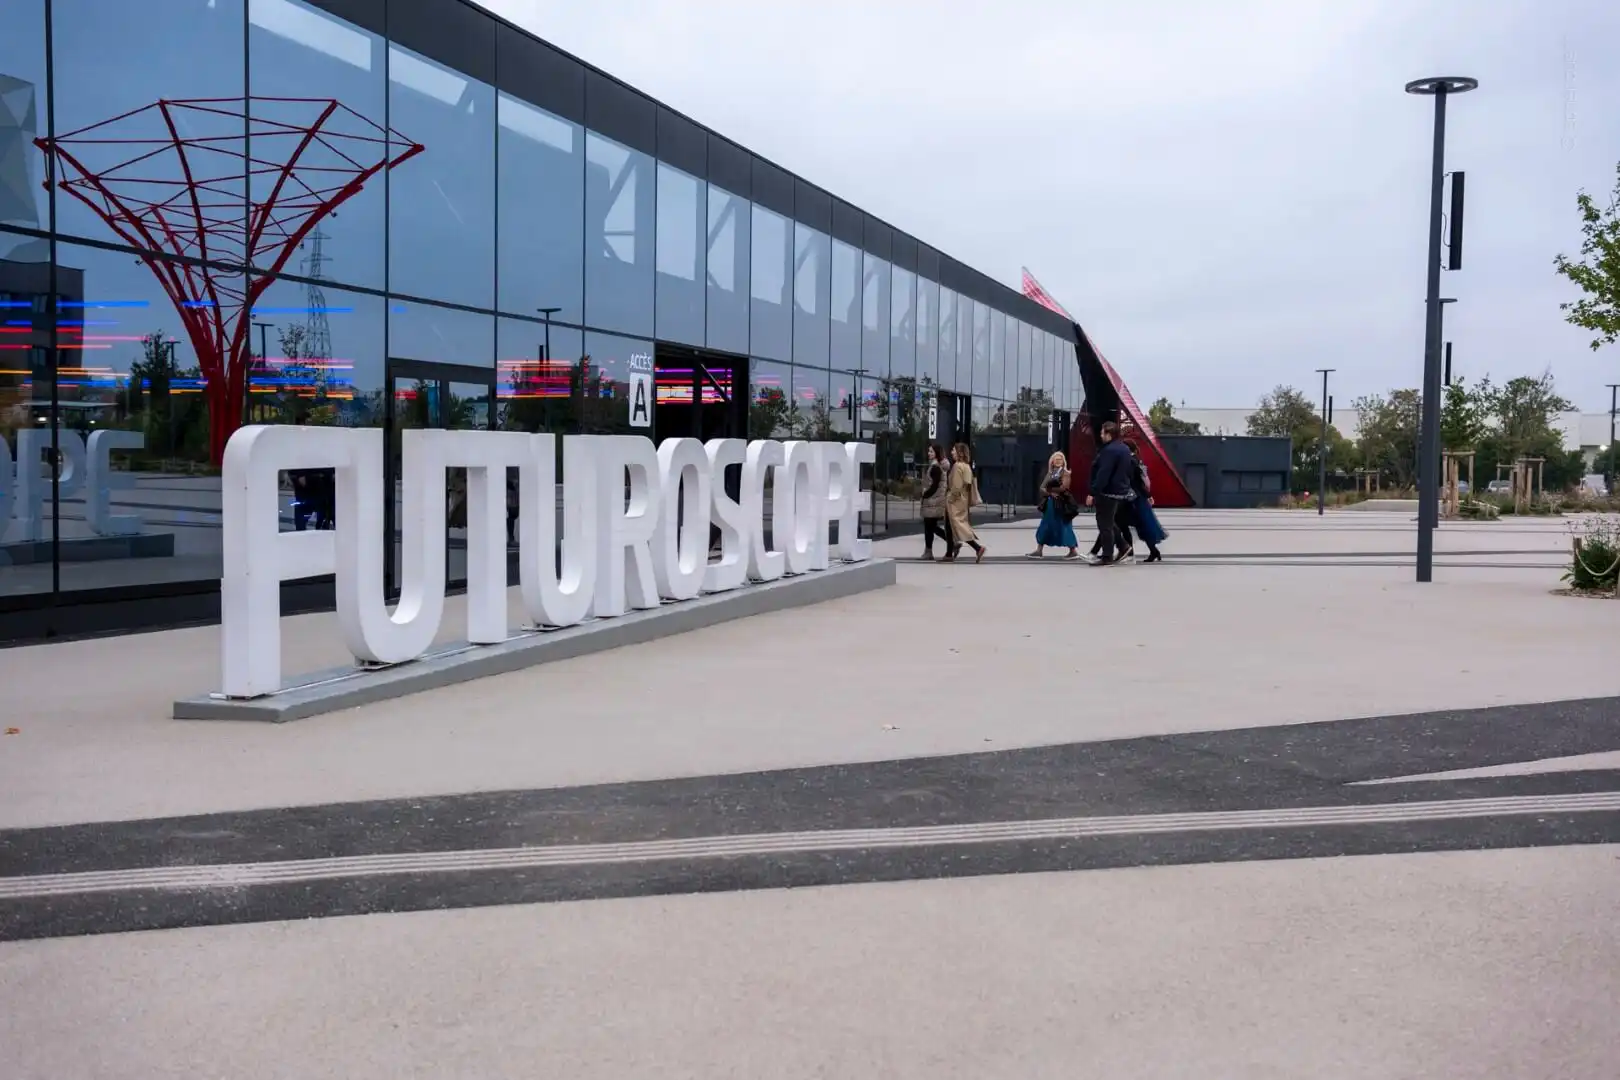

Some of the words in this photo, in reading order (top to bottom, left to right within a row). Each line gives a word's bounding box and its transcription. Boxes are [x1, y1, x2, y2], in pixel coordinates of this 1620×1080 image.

[630, 352, 652, 370] ACCÈS
[634, 378, 647, 421] A
[222, 425, 876, 698] FUTUROSCOPE
